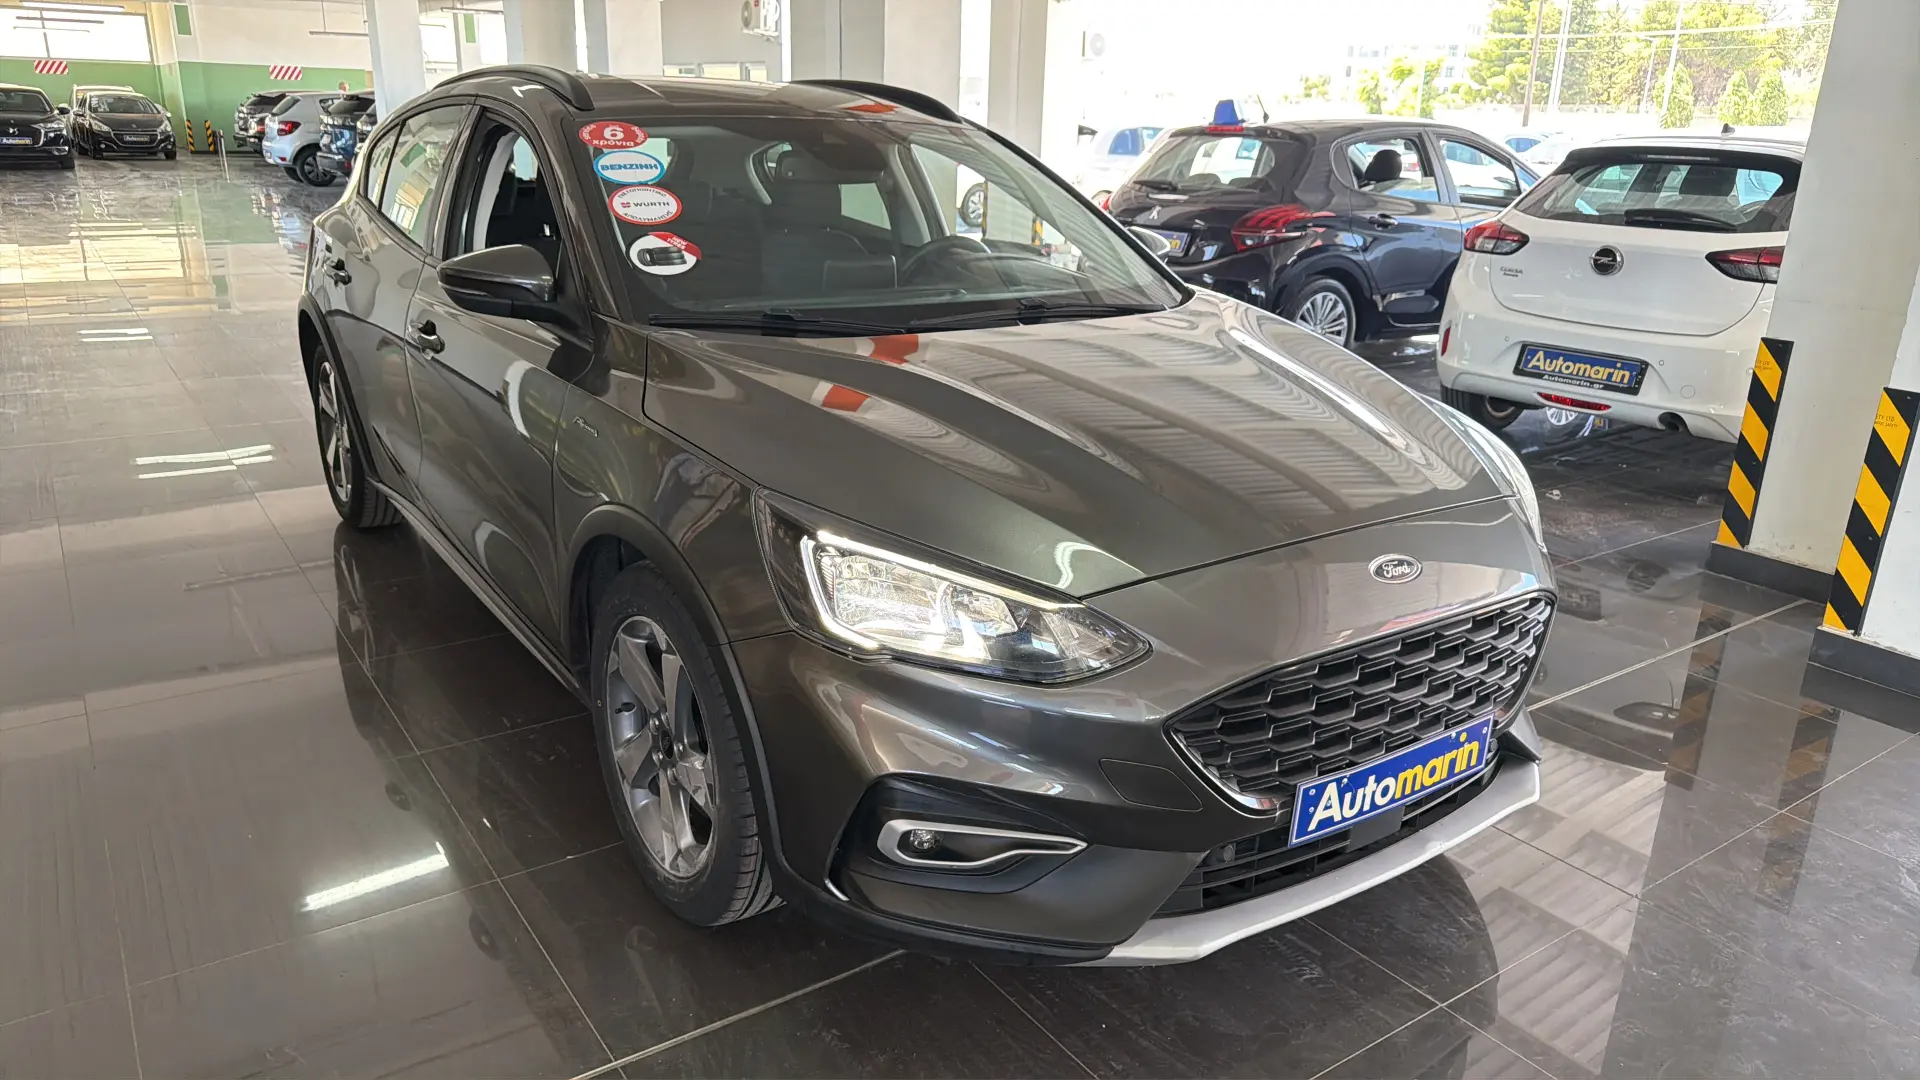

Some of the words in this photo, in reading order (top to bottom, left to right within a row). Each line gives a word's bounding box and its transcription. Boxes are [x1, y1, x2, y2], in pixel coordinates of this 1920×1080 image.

[603, 126, 625, 140] 6
[1527, 351, 1630, 384] Automarin
[1543, 375, 1605, 389] Automarin.gr
[1382, 561, 1411, 578] Ford
[1307, 732, 1479, 831] Automarin
